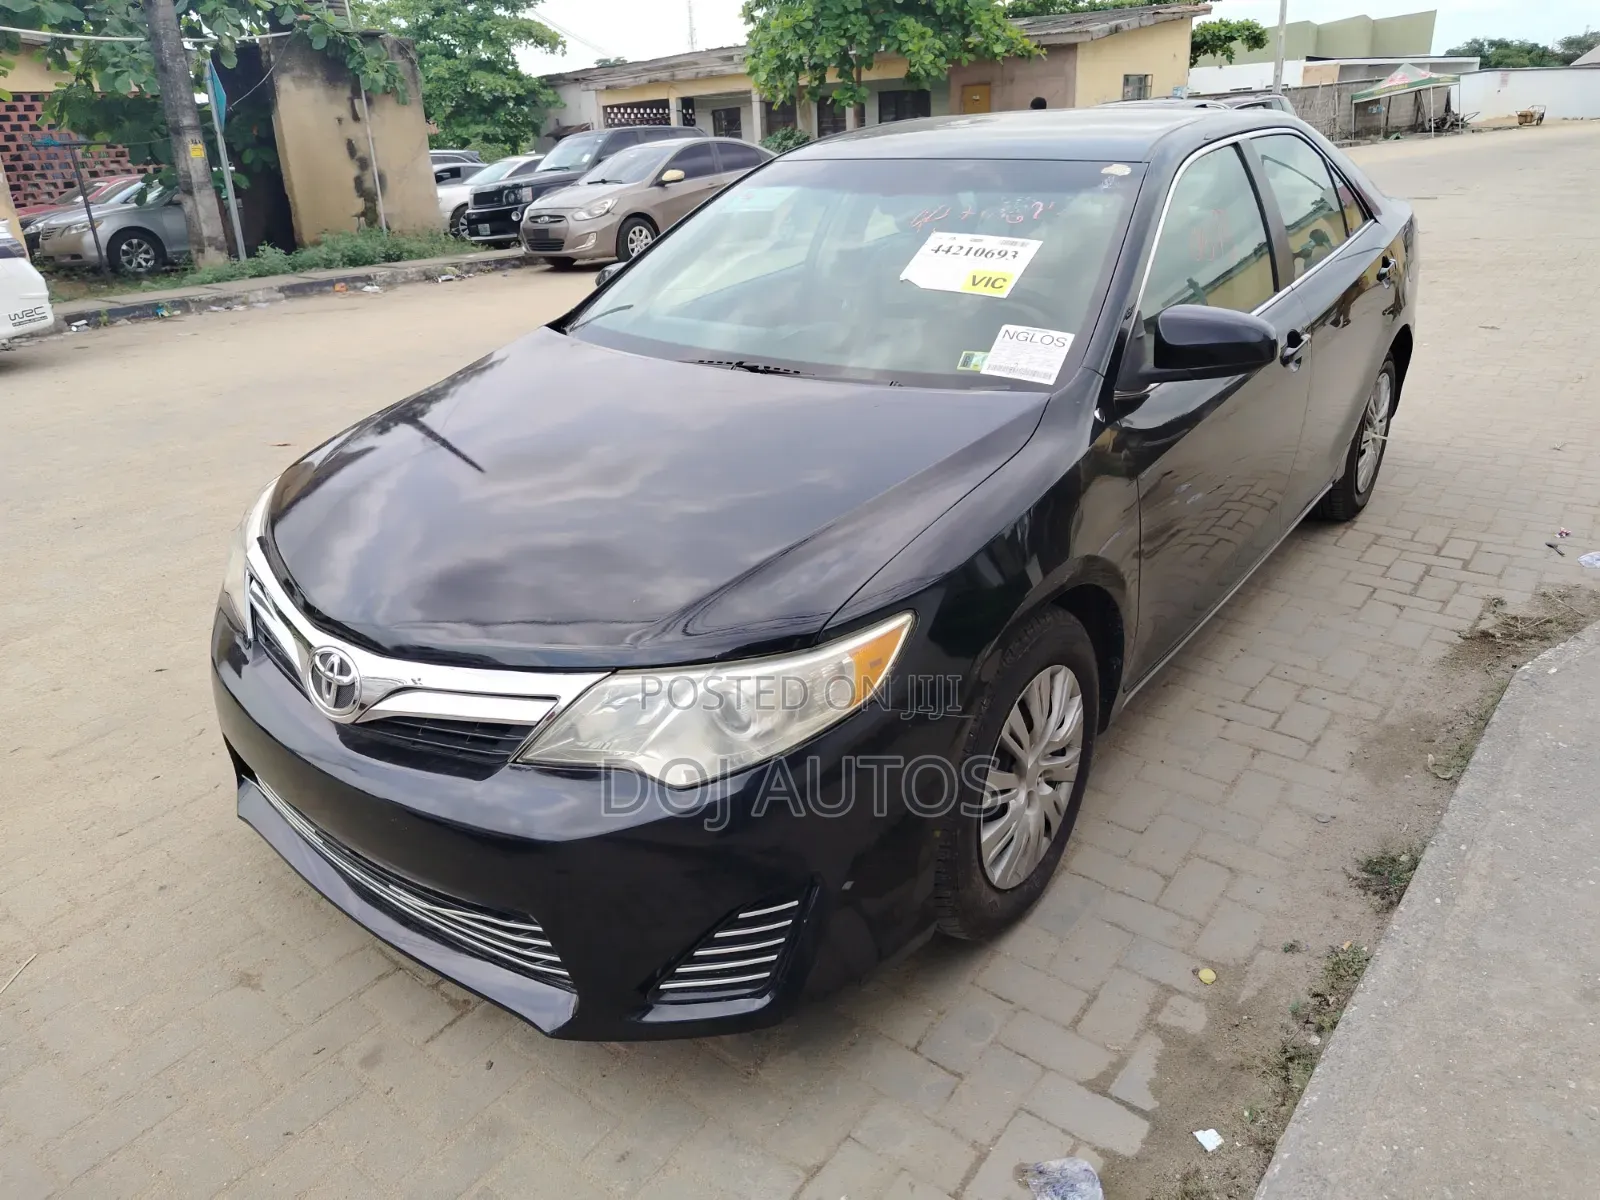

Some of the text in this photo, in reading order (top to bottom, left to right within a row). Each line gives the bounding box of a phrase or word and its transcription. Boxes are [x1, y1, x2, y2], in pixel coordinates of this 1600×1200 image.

[930, 243, 1019, 260] 44210693
[971, 274, 1008, 290] VIC
[8, 305, 46, 322] WRC
[1002, 329, 1068, 348] NGLOS
